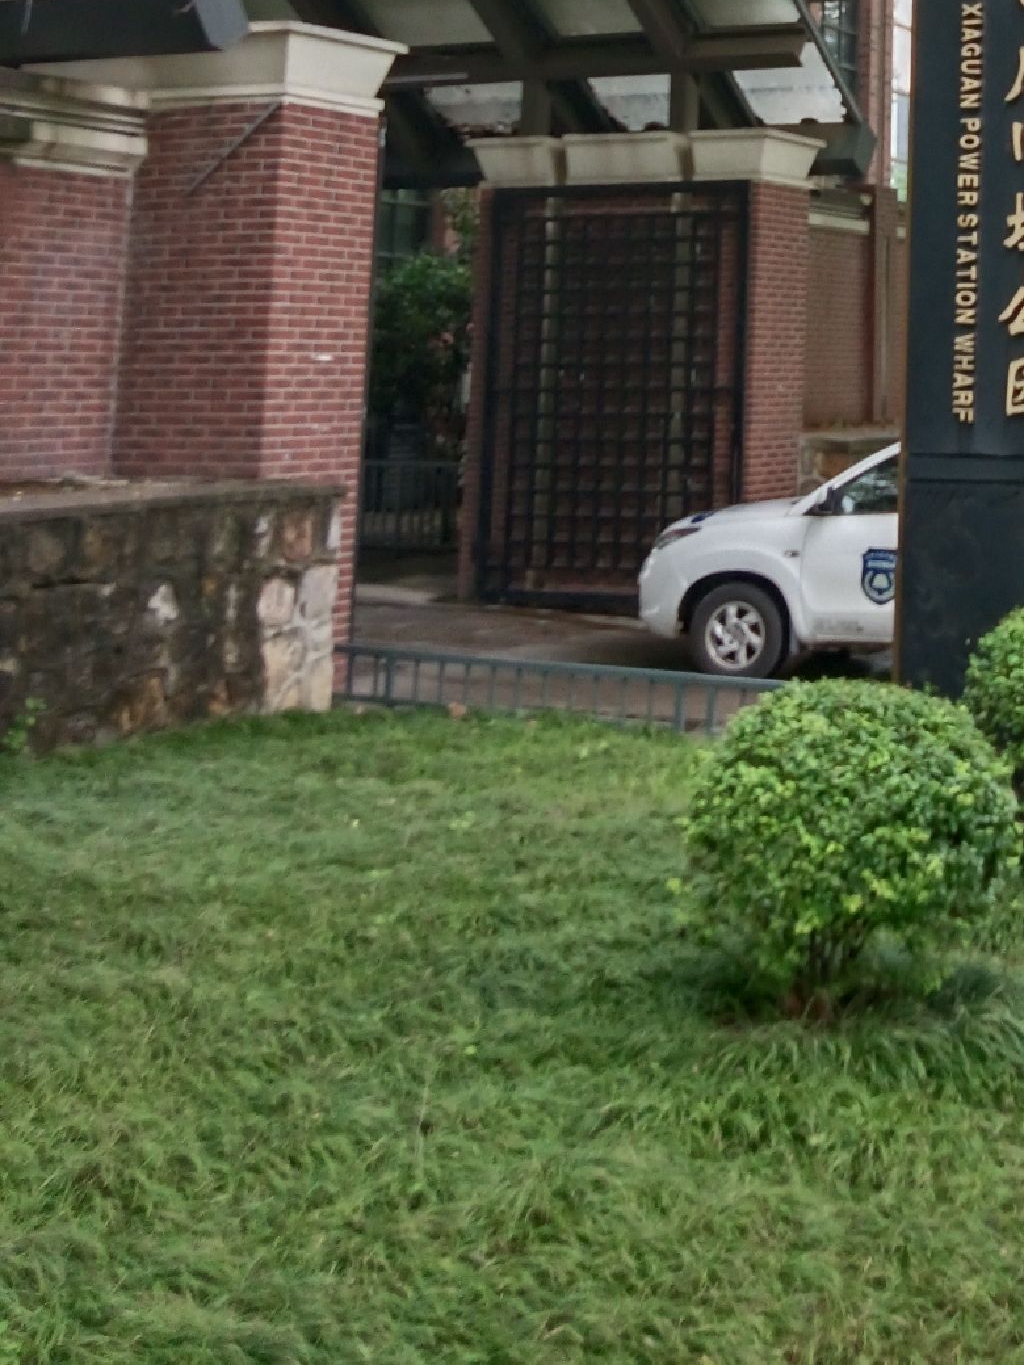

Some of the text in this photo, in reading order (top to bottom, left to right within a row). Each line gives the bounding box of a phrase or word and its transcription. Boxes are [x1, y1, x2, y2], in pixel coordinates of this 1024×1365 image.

[959, 2, 984, 110] XIAGUAN
[957, 117, 982, 207] POWER
[955, 213, 979, 325] STATION
[952, 332, 976, 424] WHARF
